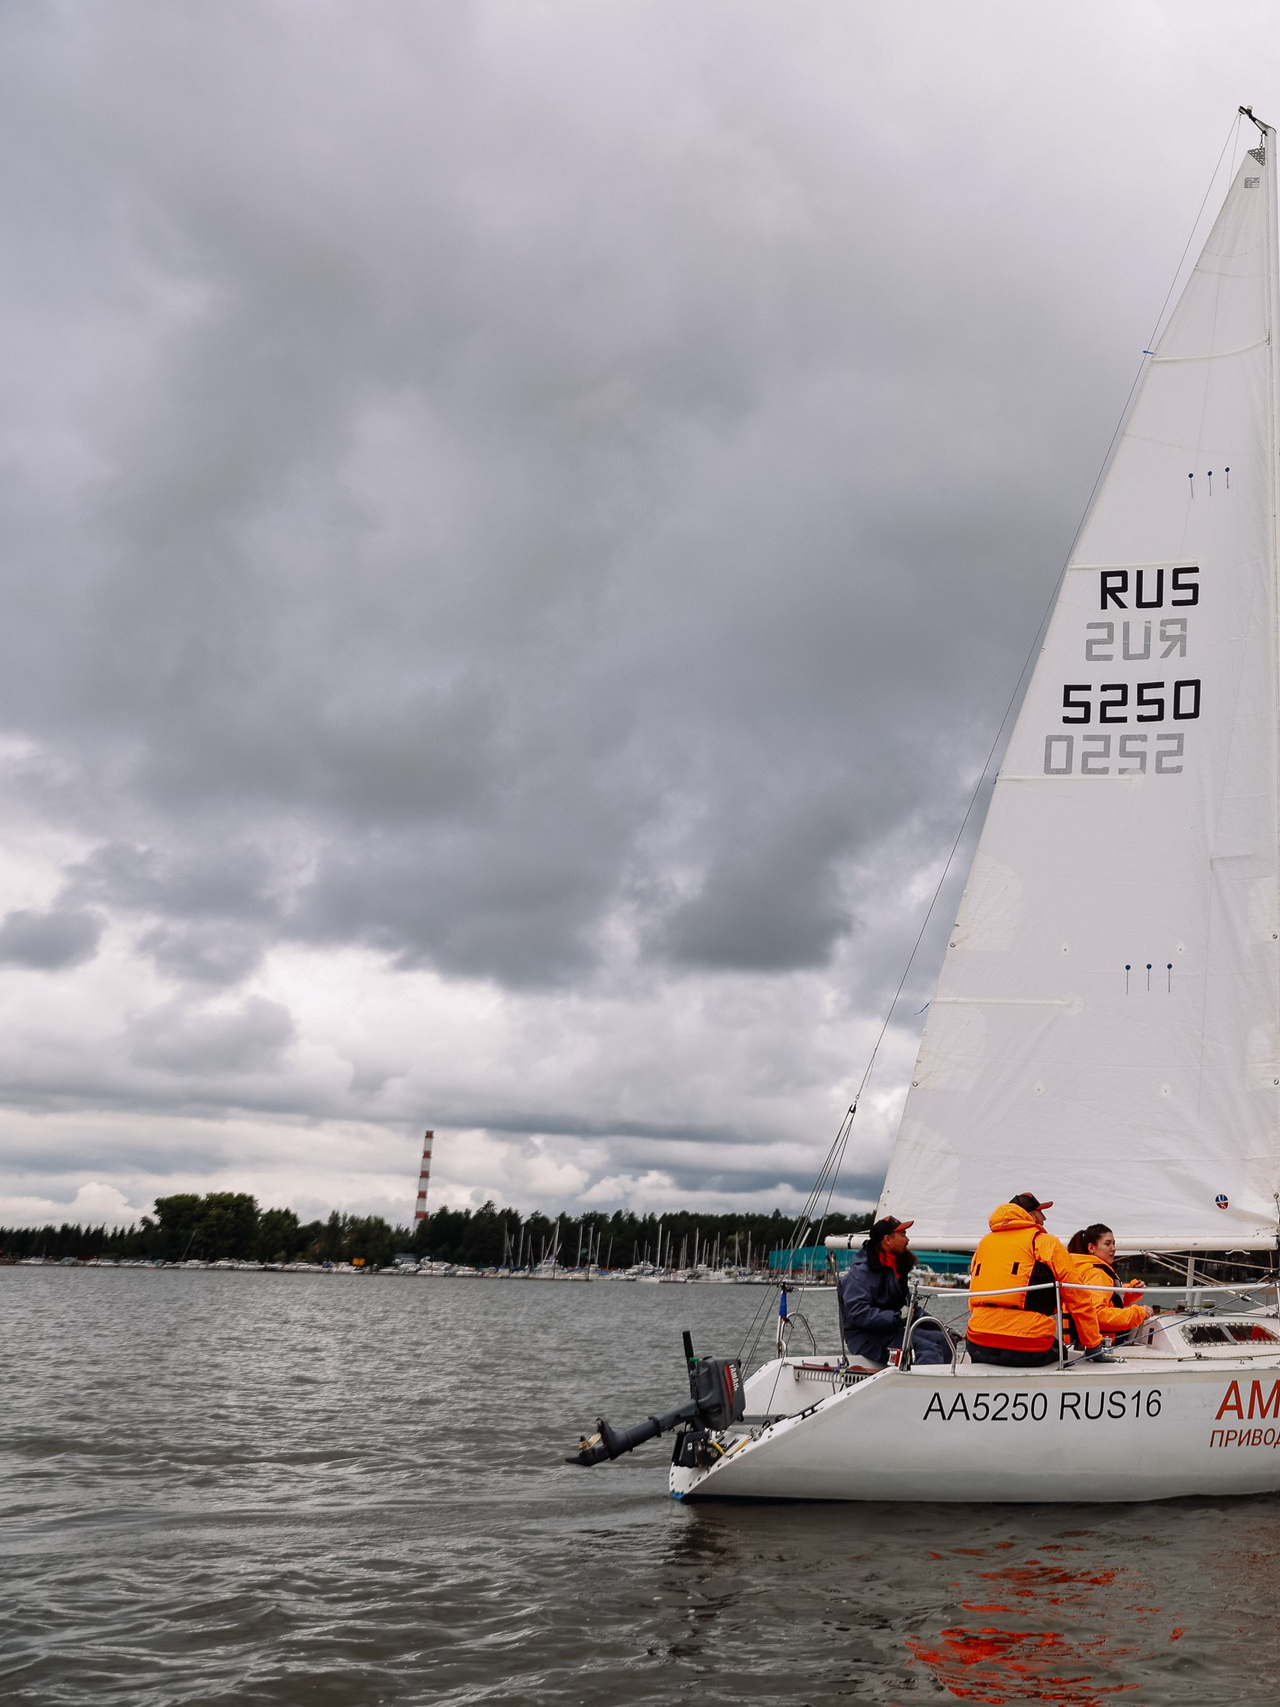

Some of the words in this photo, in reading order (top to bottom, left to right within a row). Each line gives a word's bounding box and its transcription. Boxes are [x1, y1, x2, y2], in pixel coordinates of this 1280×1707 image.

[1100, 566, 1200, 610] RUS
[1061, 678, 1202, 724] 5250
[922, 1392, 1048, 1421] AA5250
[1059, 1389, 1162, 1420] RUS16
